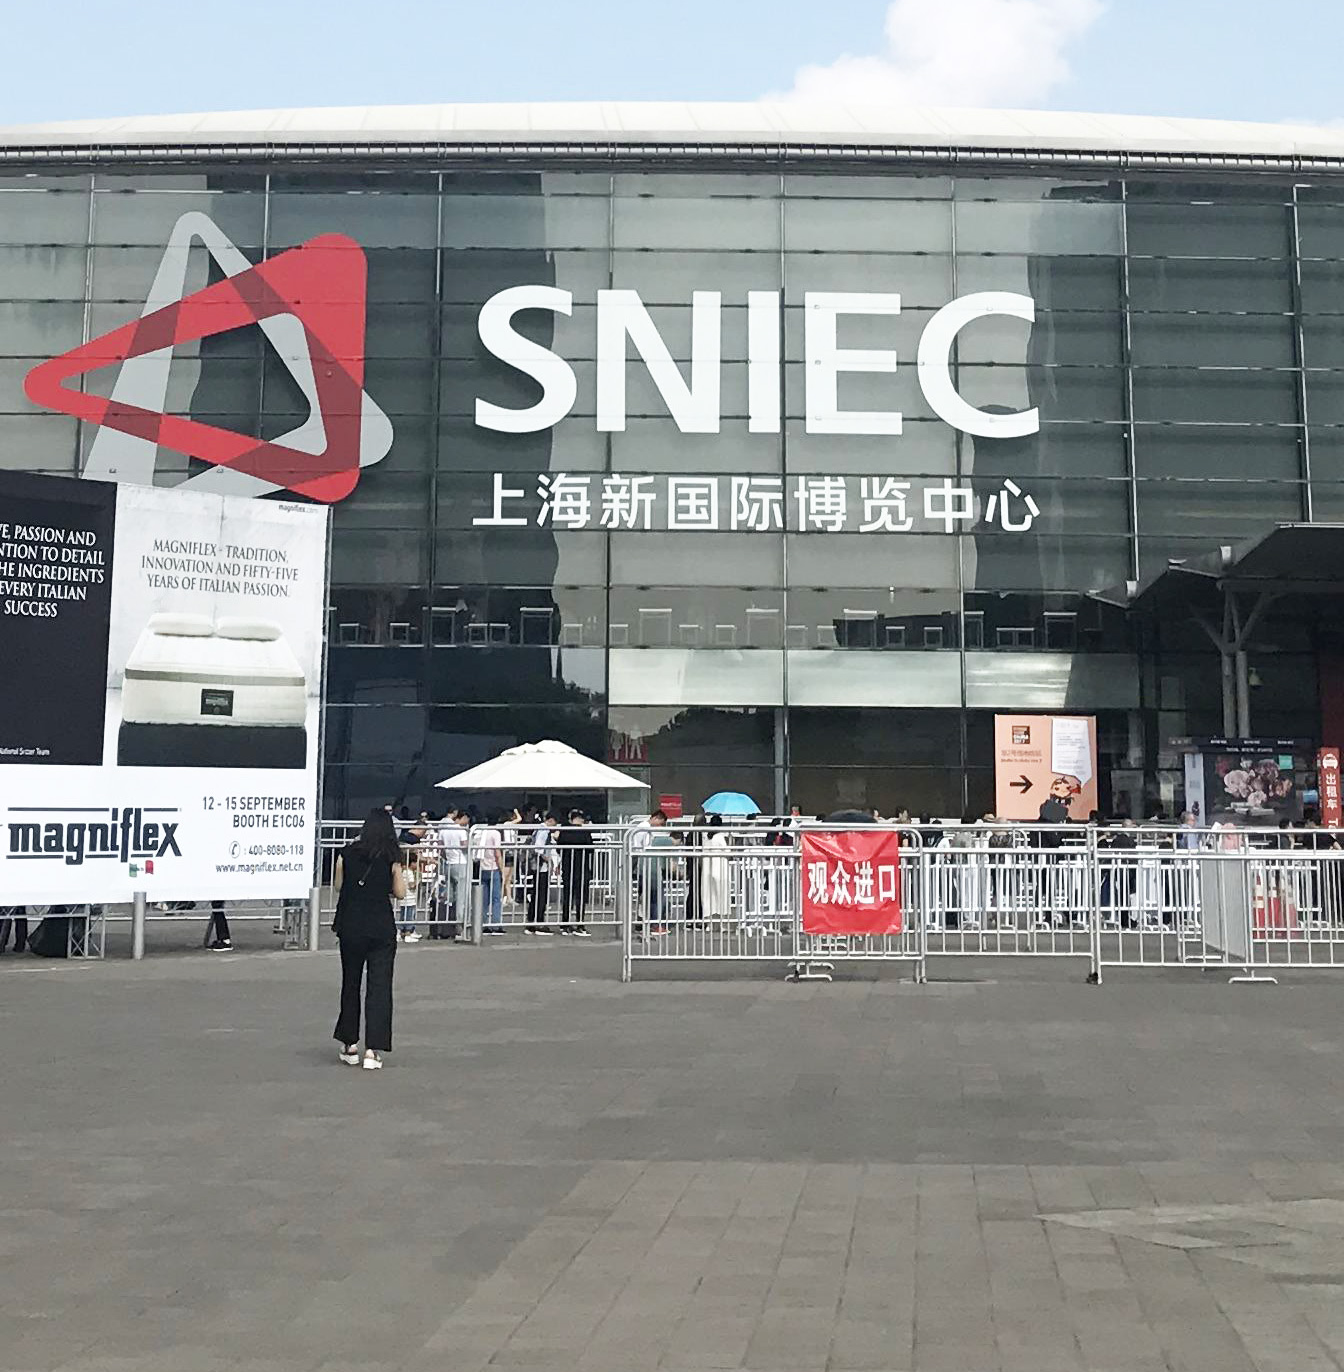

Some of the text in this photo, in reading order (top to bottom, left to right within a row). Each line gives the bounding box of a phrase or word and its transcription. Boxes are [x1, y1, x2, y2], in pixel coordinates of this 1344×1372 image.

[475, 285, 1040, 438] SNIEC
[472, 472, 1041, 533] 上海新国际博览中心
[14, 525, 65, 543] PASSION
[66, 530, 96, 546] AND
[40, 547, 59, 562] TO
[61, 548, 105, 565] DETAIL
[153, 539, 217, 557] MAGNIFLEX
[17, 563, 105, 584] INGREDIENTS
[142, 555, 299, 581] INNOVATION AND FIFTY-FIVE
[37, 583, 87, 600] ITALIAN
[147, 574, 179, 589] YEARS
[182, 577, 196, 590] OF
[200, 578, 240, 594] ITALIAN
[4, 600, 58, 618] SUCCESS
[1325, 772, 1338, 811] 出租车
[203, 796, 215, 810] 12
[225, 796, 237, 810] 15
[239, 796, 306, 811] SEPTEMBER
[233, 814, 305, 828] BOOTH E1C06
[7, 807, 183, 865] magniflex
[215, 861, 304, 875] www.magniflex.net.cn
[807, 859, 896, 905] 观众进口
